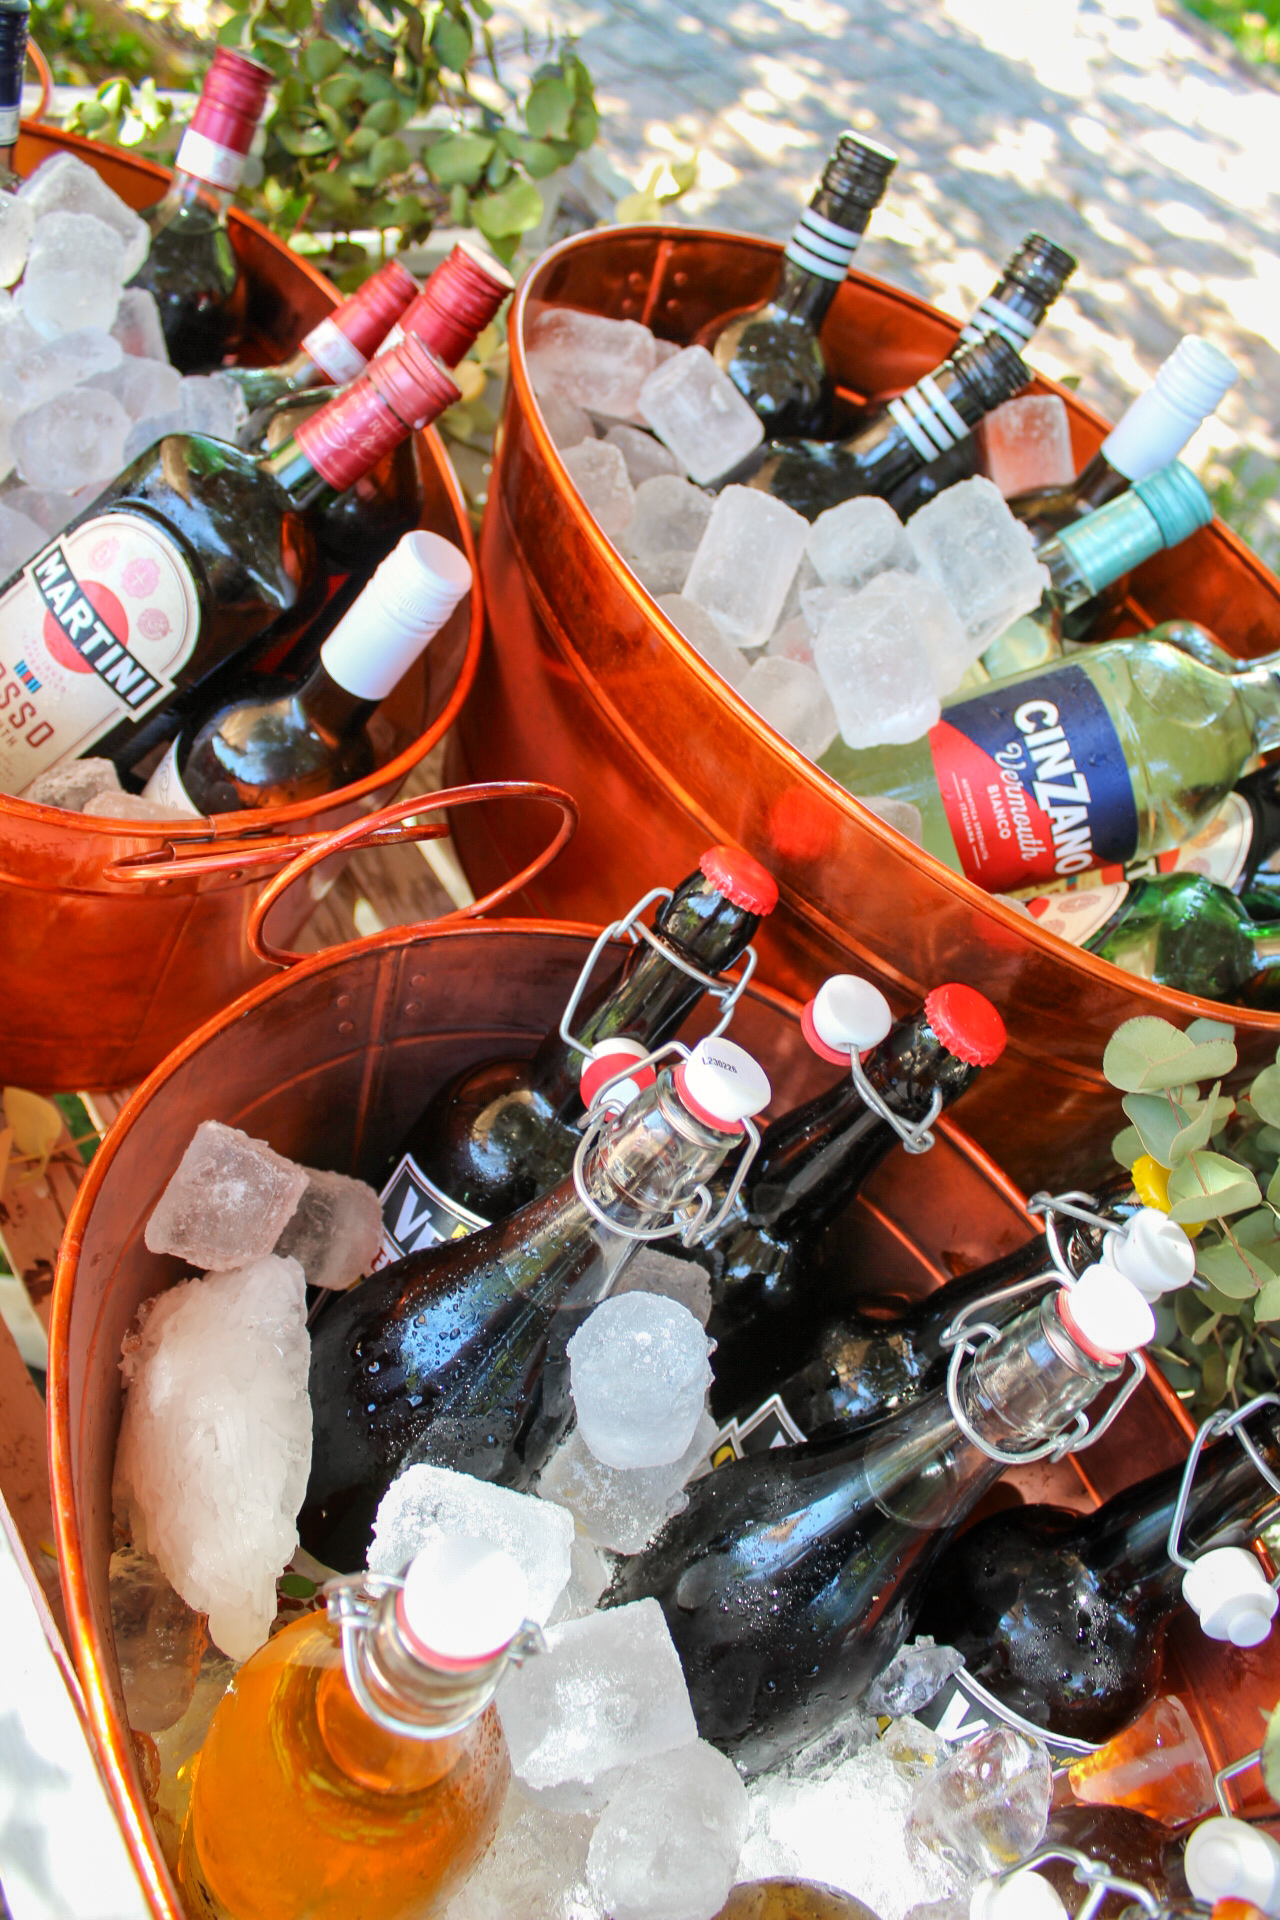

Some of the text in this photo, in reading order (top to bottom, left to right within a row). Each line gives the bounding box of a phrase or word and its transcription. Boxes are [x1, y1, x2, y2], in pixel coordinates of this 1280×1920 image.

[33, 549, 157, 705] MARTINI
[959, 802, 975, 844] ITALIANA
[987, 784, 1012, 840] BIANCO
[994, 741, 1047, 861] Vermouth
[1014, 699, 1093, 875] CINZANO
